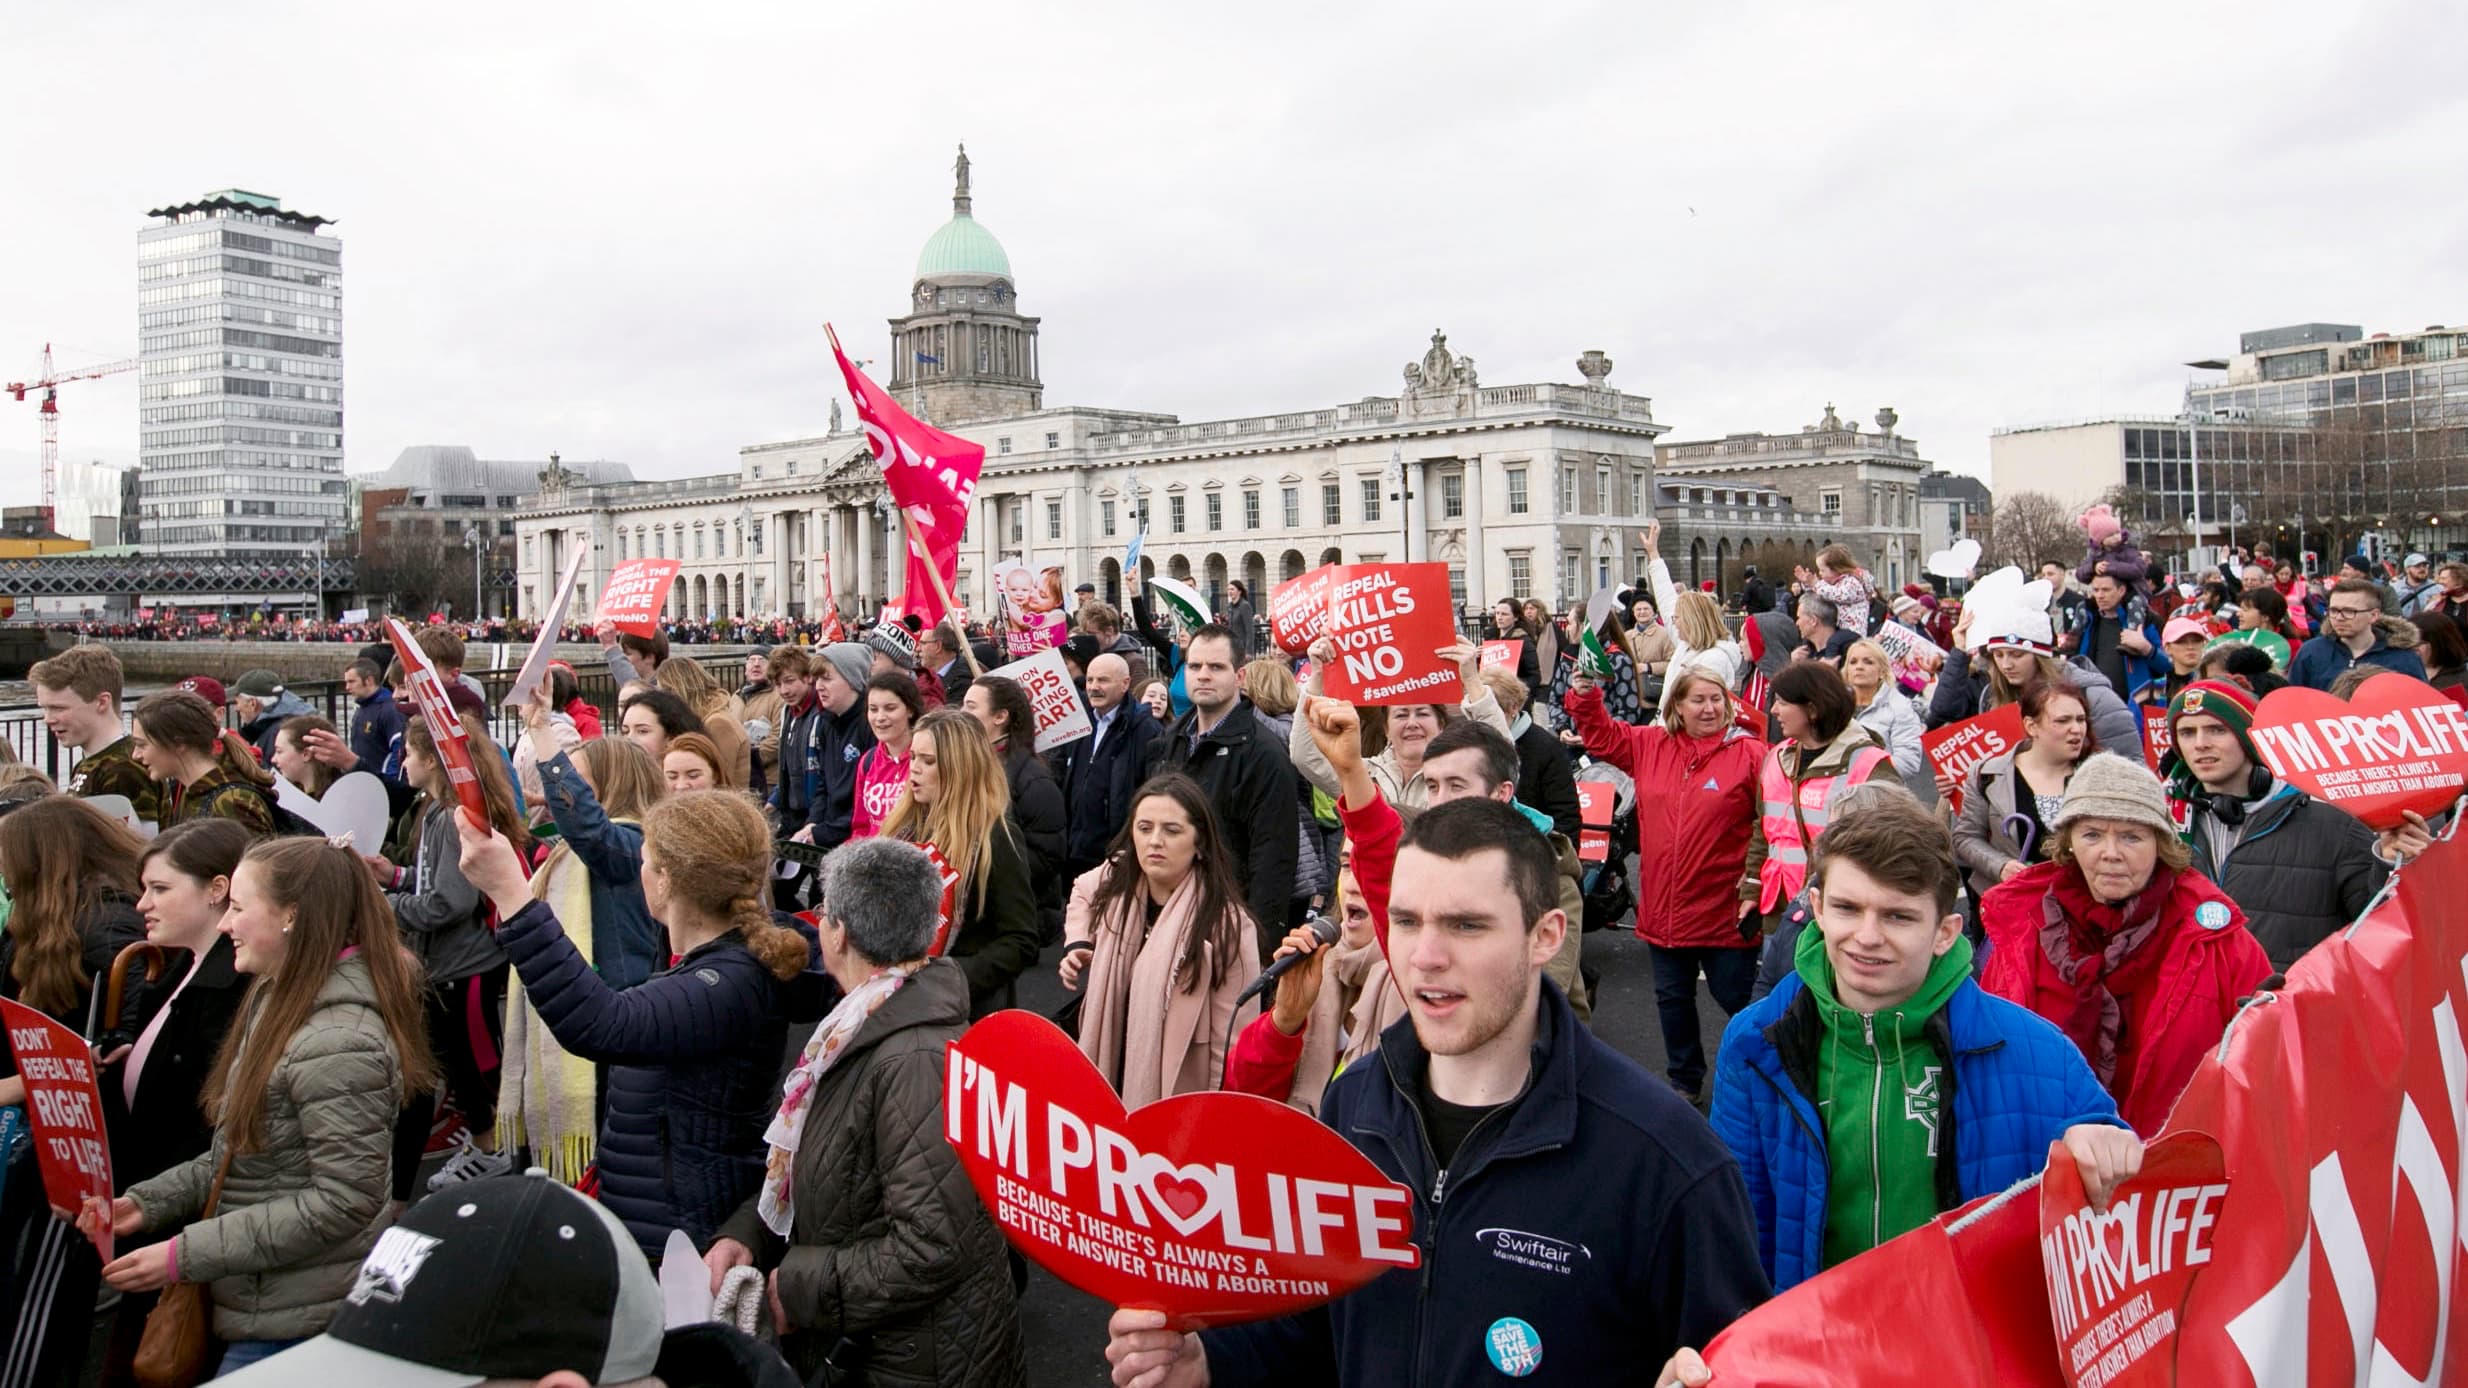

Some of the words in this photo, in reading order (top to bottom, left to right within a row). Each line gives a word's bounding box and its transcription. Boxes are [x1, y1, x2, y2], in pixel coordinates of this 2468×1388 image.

[649, 566, 671, 577] THE
[1333, 571, 1396, 601] REPEAL
[605, 578, 659, 601] RIGHT
[614, 593, 653, 609] LIFE
[1274, 581, 1302, 607] DON'T
[1275, 591, 1309, 618] REPEAL
[1310, 574, 1329, 592] THE
[604, 613, 649, 623] voteNO
[1278, 591, 1324, 636] RIGHT
[1333, 587, 1415, 631] KILLS
[878, 622, 916, 652] CONS
[1286, 634, 1300, 647] TO
[1299, 610, 1329, 643] LIFE
[1335, 624, 1394, 651] VOTE
[1884, 623, 1916, 644] LOVE
[1482, 650, 1511, 665] KILLS
[1879, 635, 1911, 653] HEM
[1343, 646, 1404, 684] NO
[1363, 669, 1456, 701] #savethe8th
[1930, 723, 1984, 762] REPEAL
[1940, 730, 2006, 784] KILLS
[2251, 722, 2330, 777] I'M
[2316, 769, 2361, 787] BECAUSE
[2359, 765, 2399, 781] THERE'S
[2399, 763, 2433, 776] ALWAYS
[2433, 761, 2441, 773] A
[2323, 784, 2364, 801] BETTER
[2362, 779, 2400, 795] ANSWER
[2399, 777, 2424, 791] THAN
[2423, 773, 2464, 789] ABORTION
[11, 1027, 52, 1051] DON'T
[21, 1058, 70, 1080] REPEAL
[67, 1058, 90, 1083] THE
[31, 1089, 97, 1132] RIGHT
[948, 1047, 1029, 1179] I'M
[48, 1137, 71, 1161] TO
[70, 1136, 108, 1182] LIFE
[997, 1173, 1073, 1229] BECAUSE
[1077, 1211, 1156, 1257] THERE'S
[1163, 1241, 1247, 1274] ALWAYS
[1254, 1259, 1269, 1276] A
[998, 1200, 1062, 1248] BETTER
[1067, 1231, 1147, 1279] ANSWER
[1153, 1261, 1210, 1291] THAN
[1216, 1274, 1329, 1297] ABORTION
[1492, 1249, 1553, 1271] Maintenance
[1555, 1265, 1571, 1274] Ltd
[1496, 1232, 1571, 1263] Swiftair
[1491, 1327, 1527, 1346] SAVE
[2071, 1330, 2099, 1374] BECAUSE
[2095, 1310, 2124, 1350] THERE'S
[2121, 1294, 2147, 1332] ALWAYS
[2099, 1342, 2130, 1385] ANSWER
[2124, 1329, 2148, 1362] THAN
[2141, 1308, 2176, 1350] ABORTION
[1496, 1340, 1530, 1359] THE
[1501, 1353, 1535, 1372] 8TH
